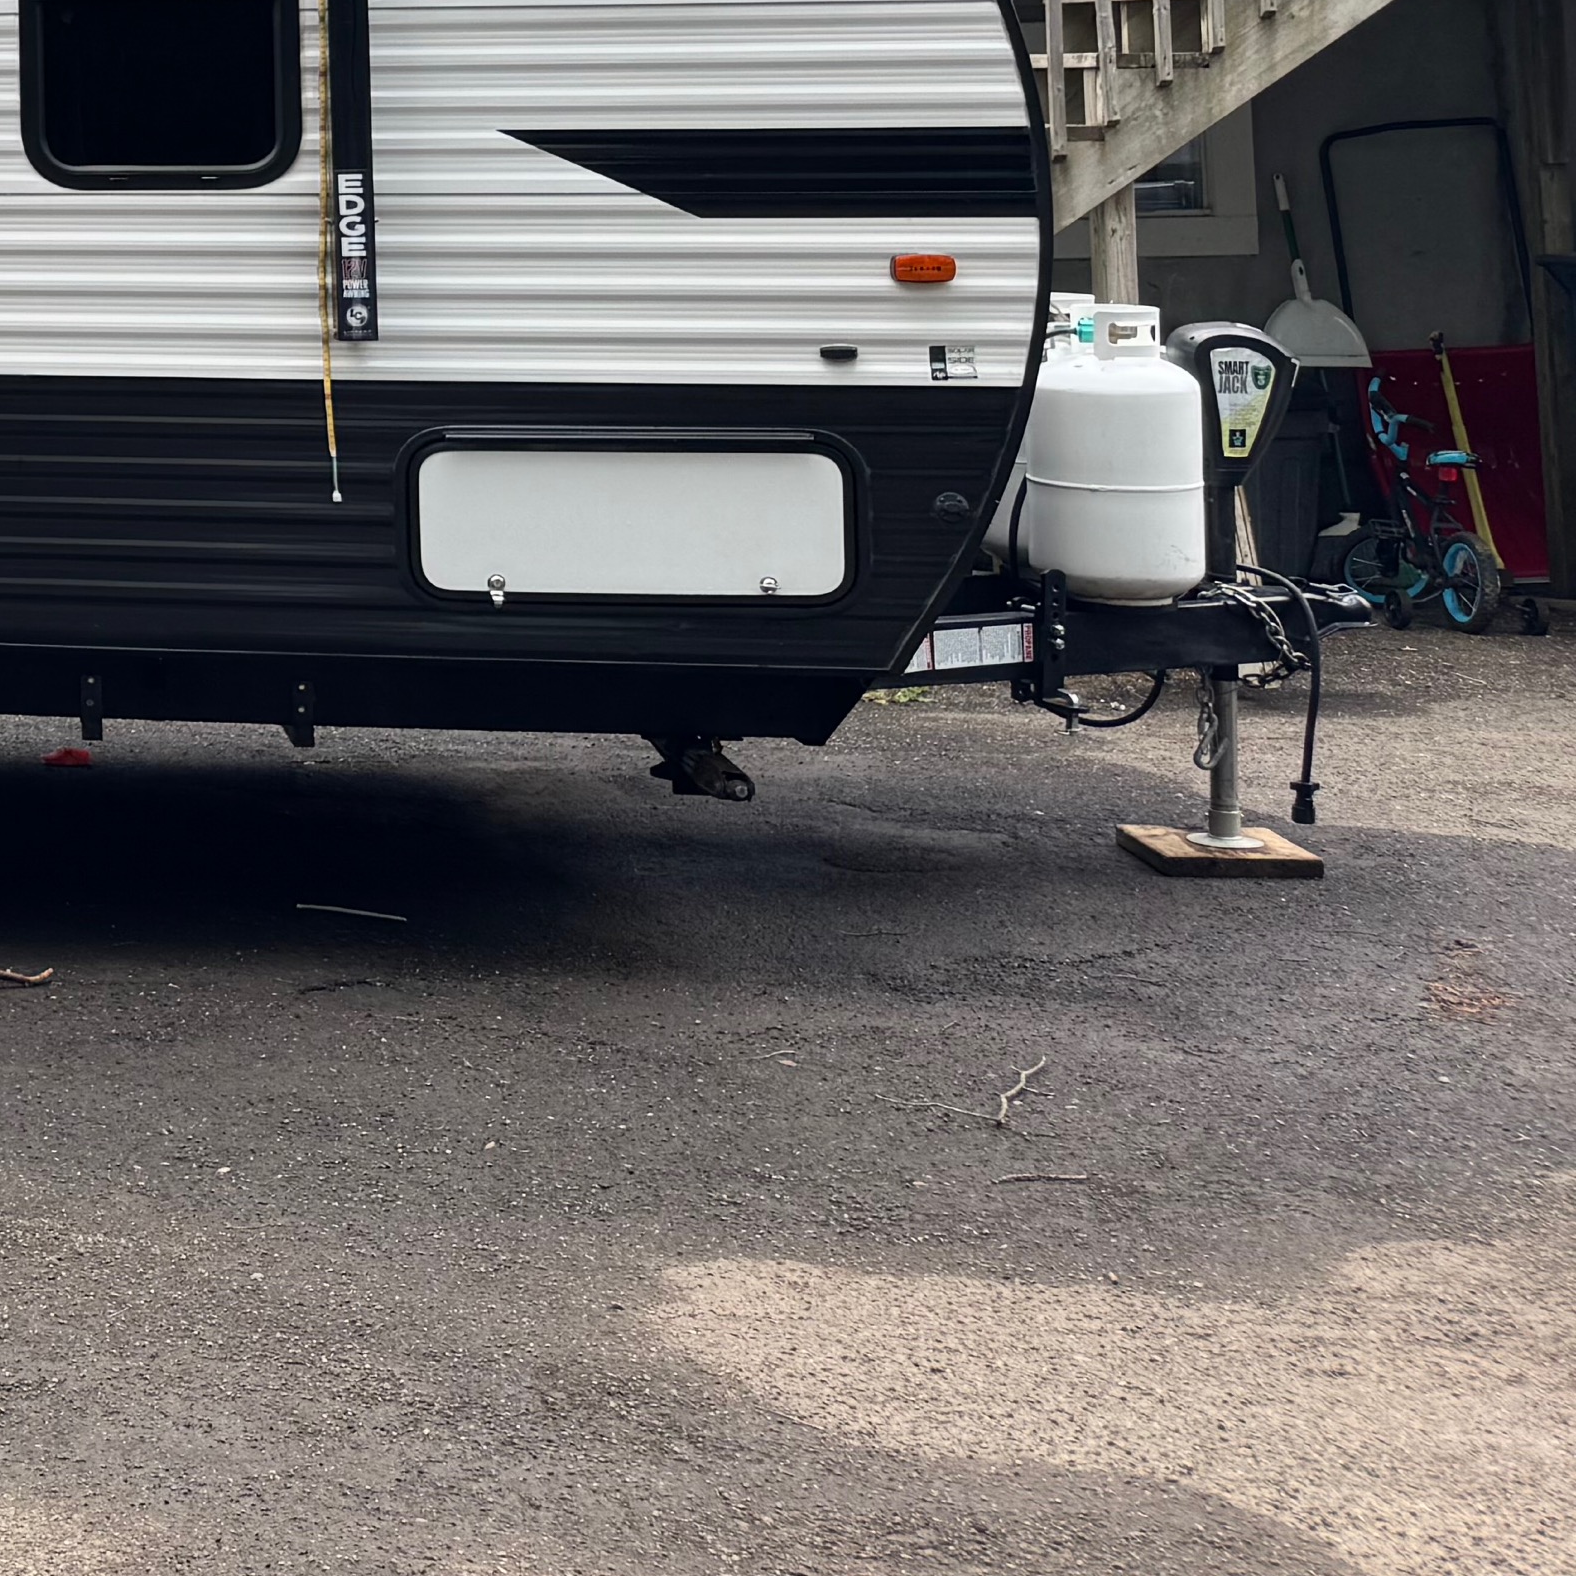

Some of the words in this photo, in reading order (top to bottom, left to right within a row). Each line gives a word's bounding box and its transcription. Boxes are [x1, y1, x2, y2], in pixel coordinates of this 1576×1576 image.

[337, 173, 367, 257] EDGE
[342, 279, 369, 290] POWER
[1218, 360, 1250, 375] SMART
[1217, 375, 1249, 394] JACK
